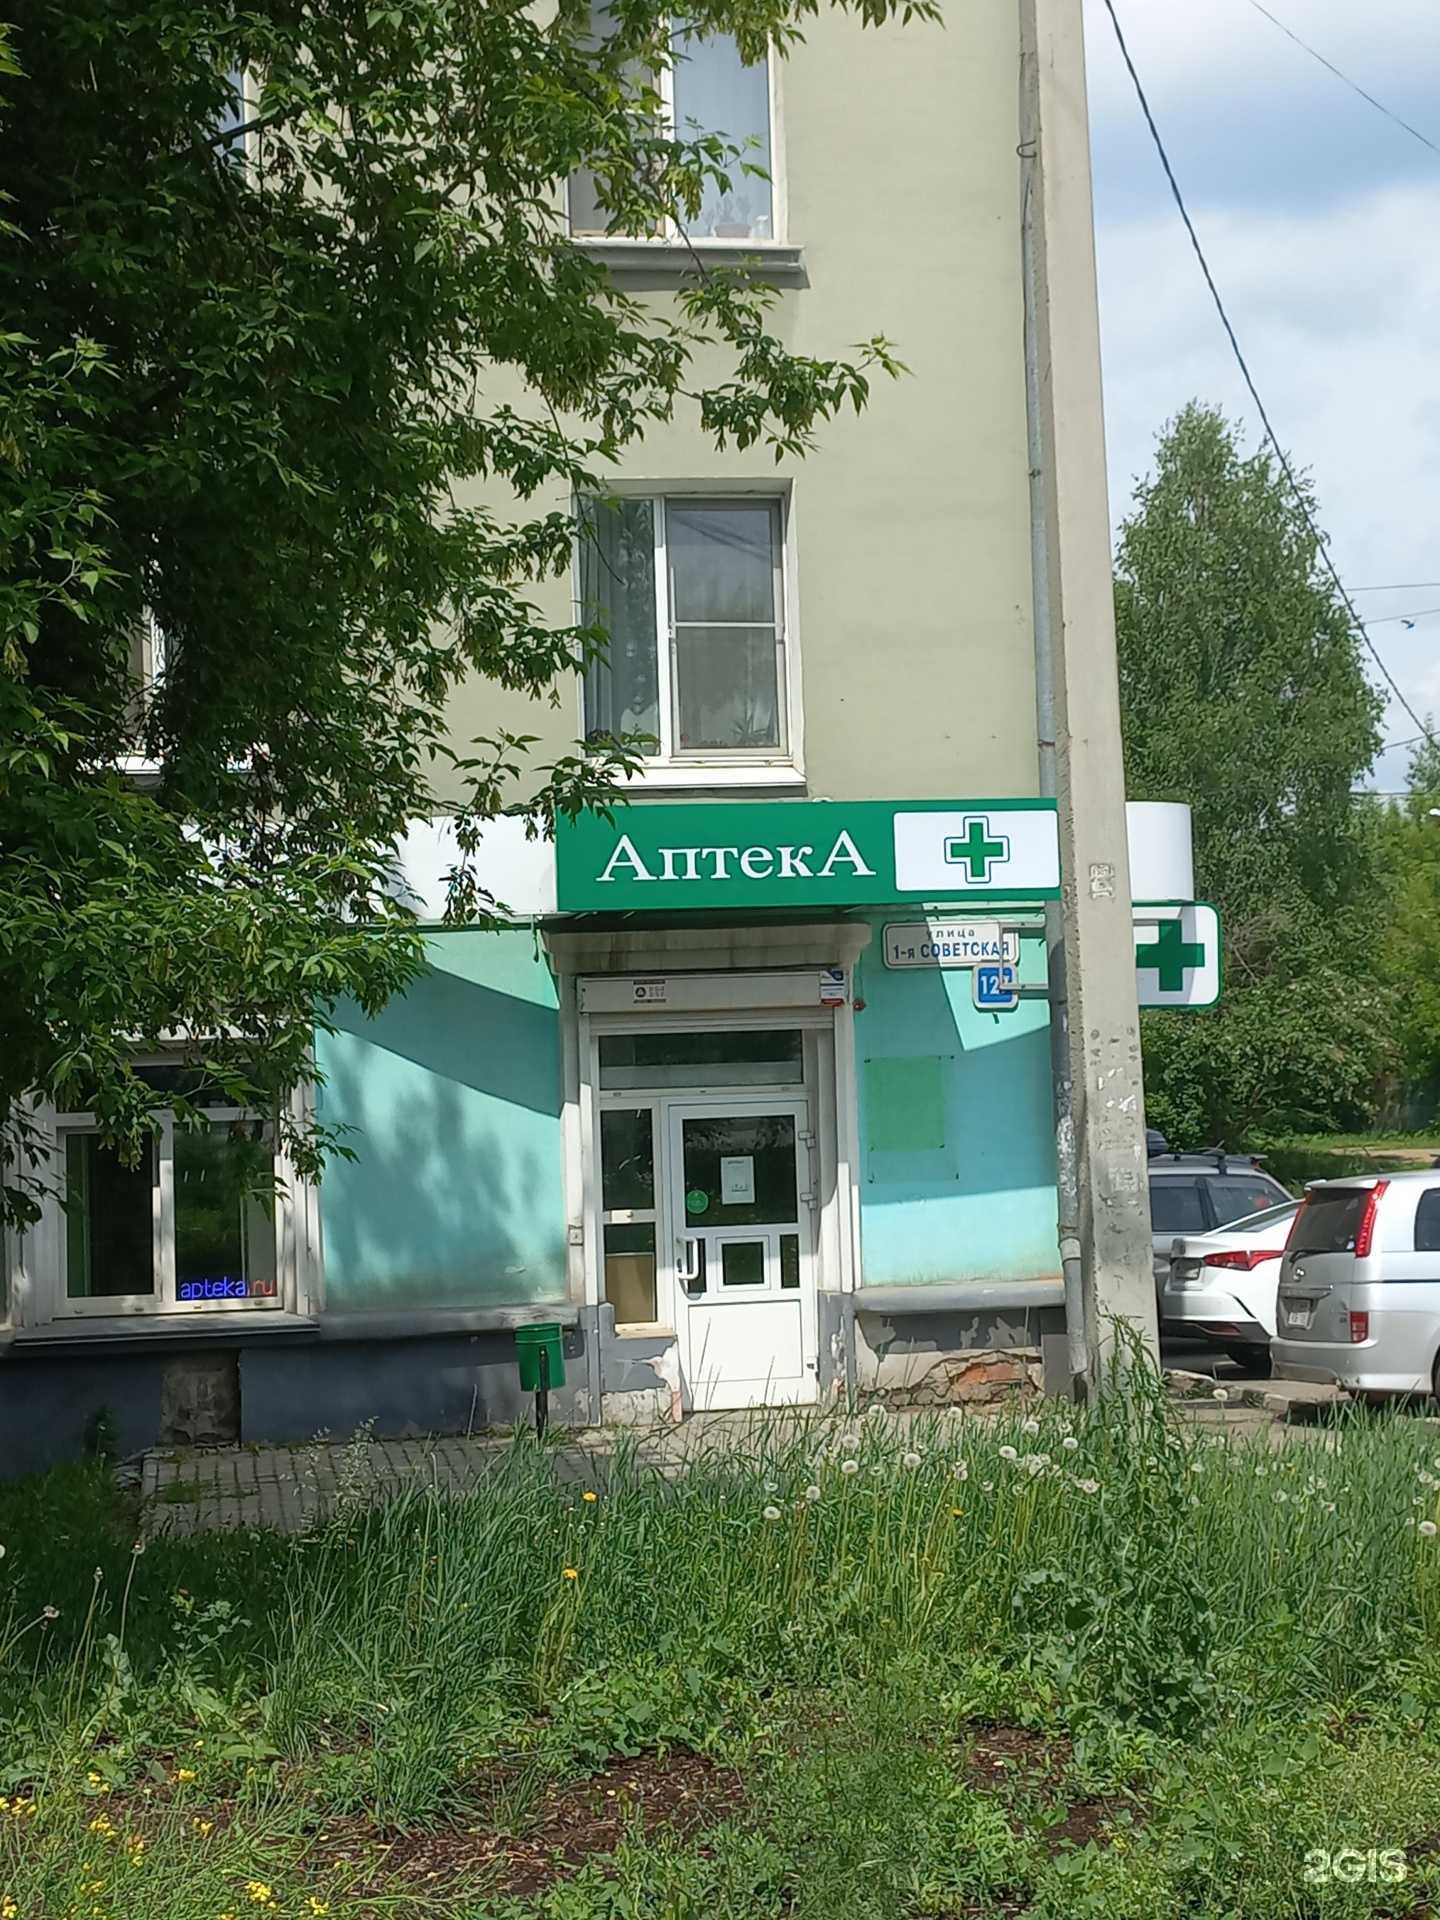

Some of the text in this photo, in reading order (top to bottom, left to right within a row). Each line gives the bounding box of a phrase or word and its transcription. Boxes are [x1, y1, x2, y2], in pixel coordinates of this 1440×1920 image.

[596, 830, 876, 882] АптекА
[893, 941, 1010, 960] 1-я СОВЕТСКАЯ
